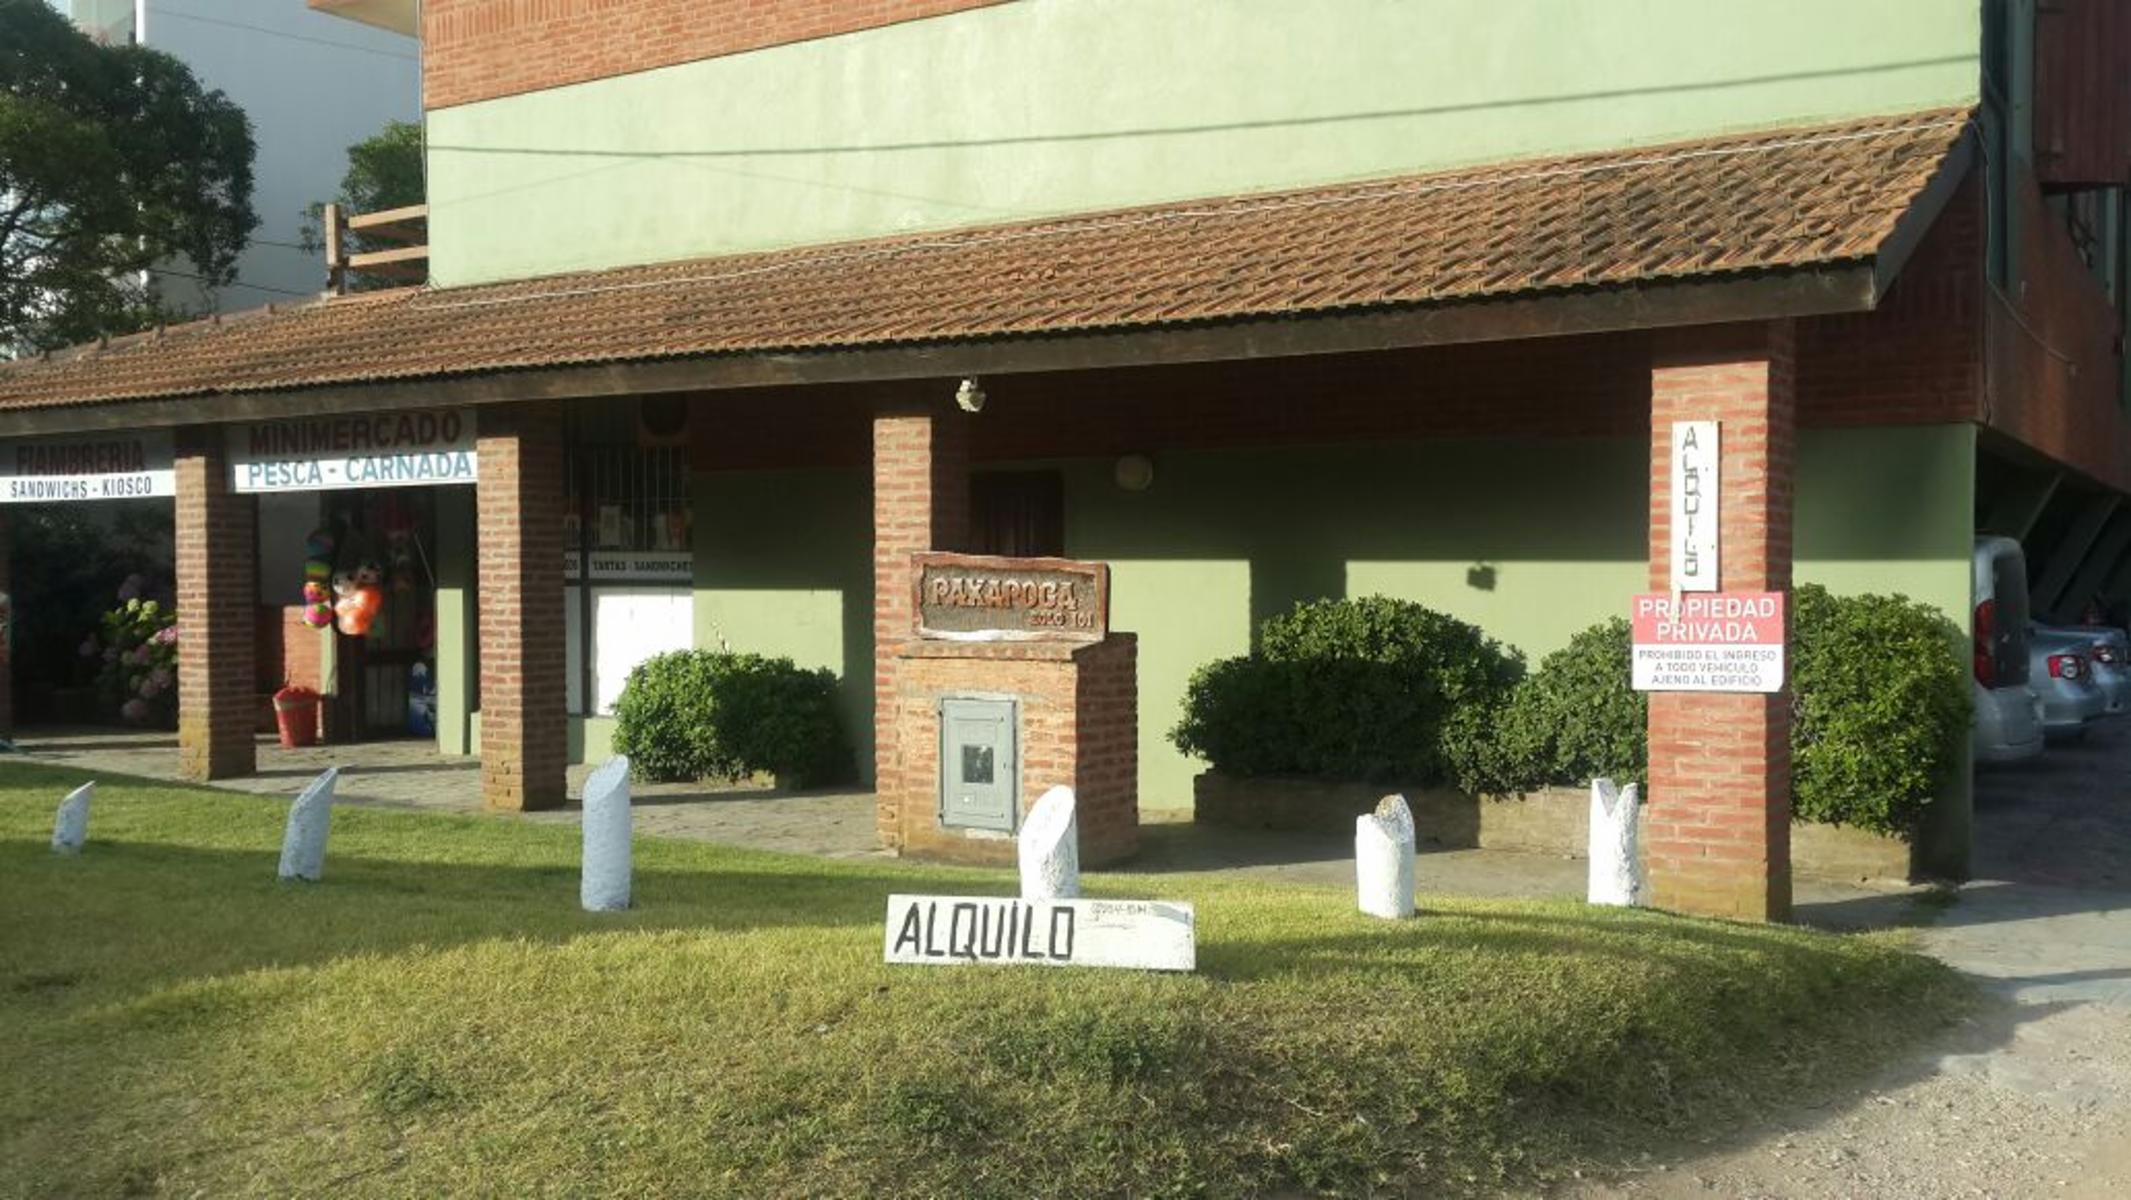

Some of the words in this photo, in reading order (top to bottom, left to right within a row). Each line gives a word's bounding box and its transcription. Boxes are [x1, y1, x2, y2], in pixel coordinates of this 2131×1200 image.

[249, 410, 462, 455] MINIMERCADO
[16, 440, 145, 475] FIAMBRERIA
[248, 460, 322, 486] PESCA
[345, 451, 472, 481] CARNADA
[10, 480, 88, 498] SANDWICHS
[102, 476, 152, 496] KIOSCO
[1682, 426, 1701, 577] ALQUILO
[1657, 622, 1758, 641] PRIVADA
[1639, 650, 1703, 660] PROHIBIDO
[1705, 650, 1719, 661] EL
[1723, 650, 1777, 661] INGRESO
[1655, 662, 1663, 672] A
[1667, 662, 1696, 672] TODO
[1699, 663, 1758, 674] VEHICULO
[1651, 675, 1690, 685] AJENO
[1692, 675, 1708, 685] AL
[1711, 675, 1763, 686] EDIFICIO
[894, 901, 1075, 960] ALQUILO
